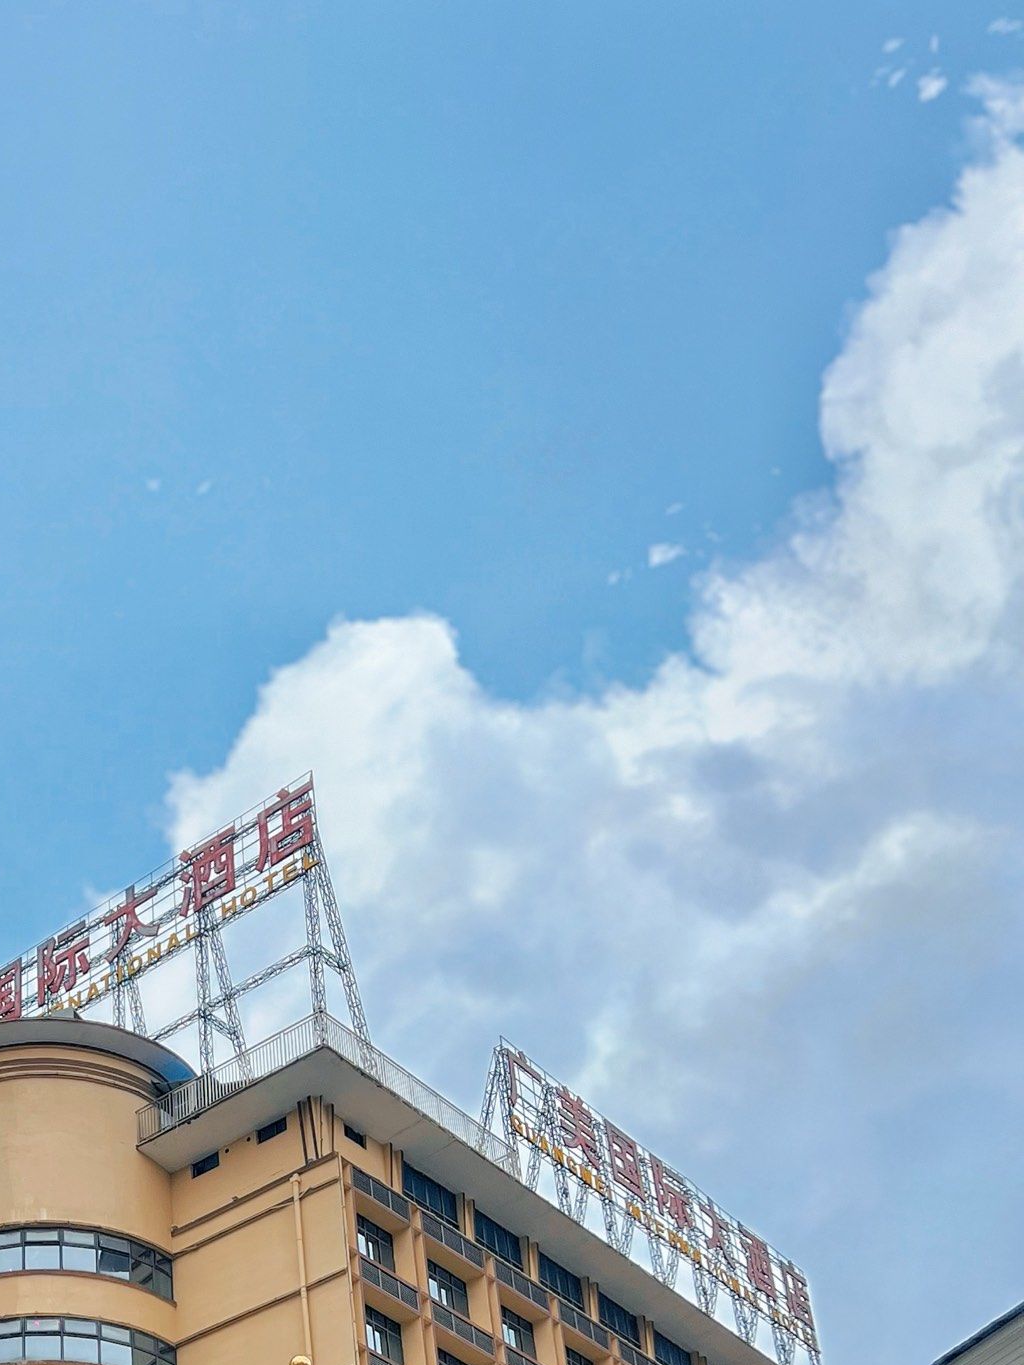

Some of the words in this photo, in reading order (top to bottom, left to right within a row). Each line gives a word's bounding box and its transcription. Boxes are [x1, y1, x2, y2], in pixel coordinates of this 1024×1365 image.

[221, 852, 319, 918] HOTEL
[503, 1047, 814, 1331] 广美国际大酒店
